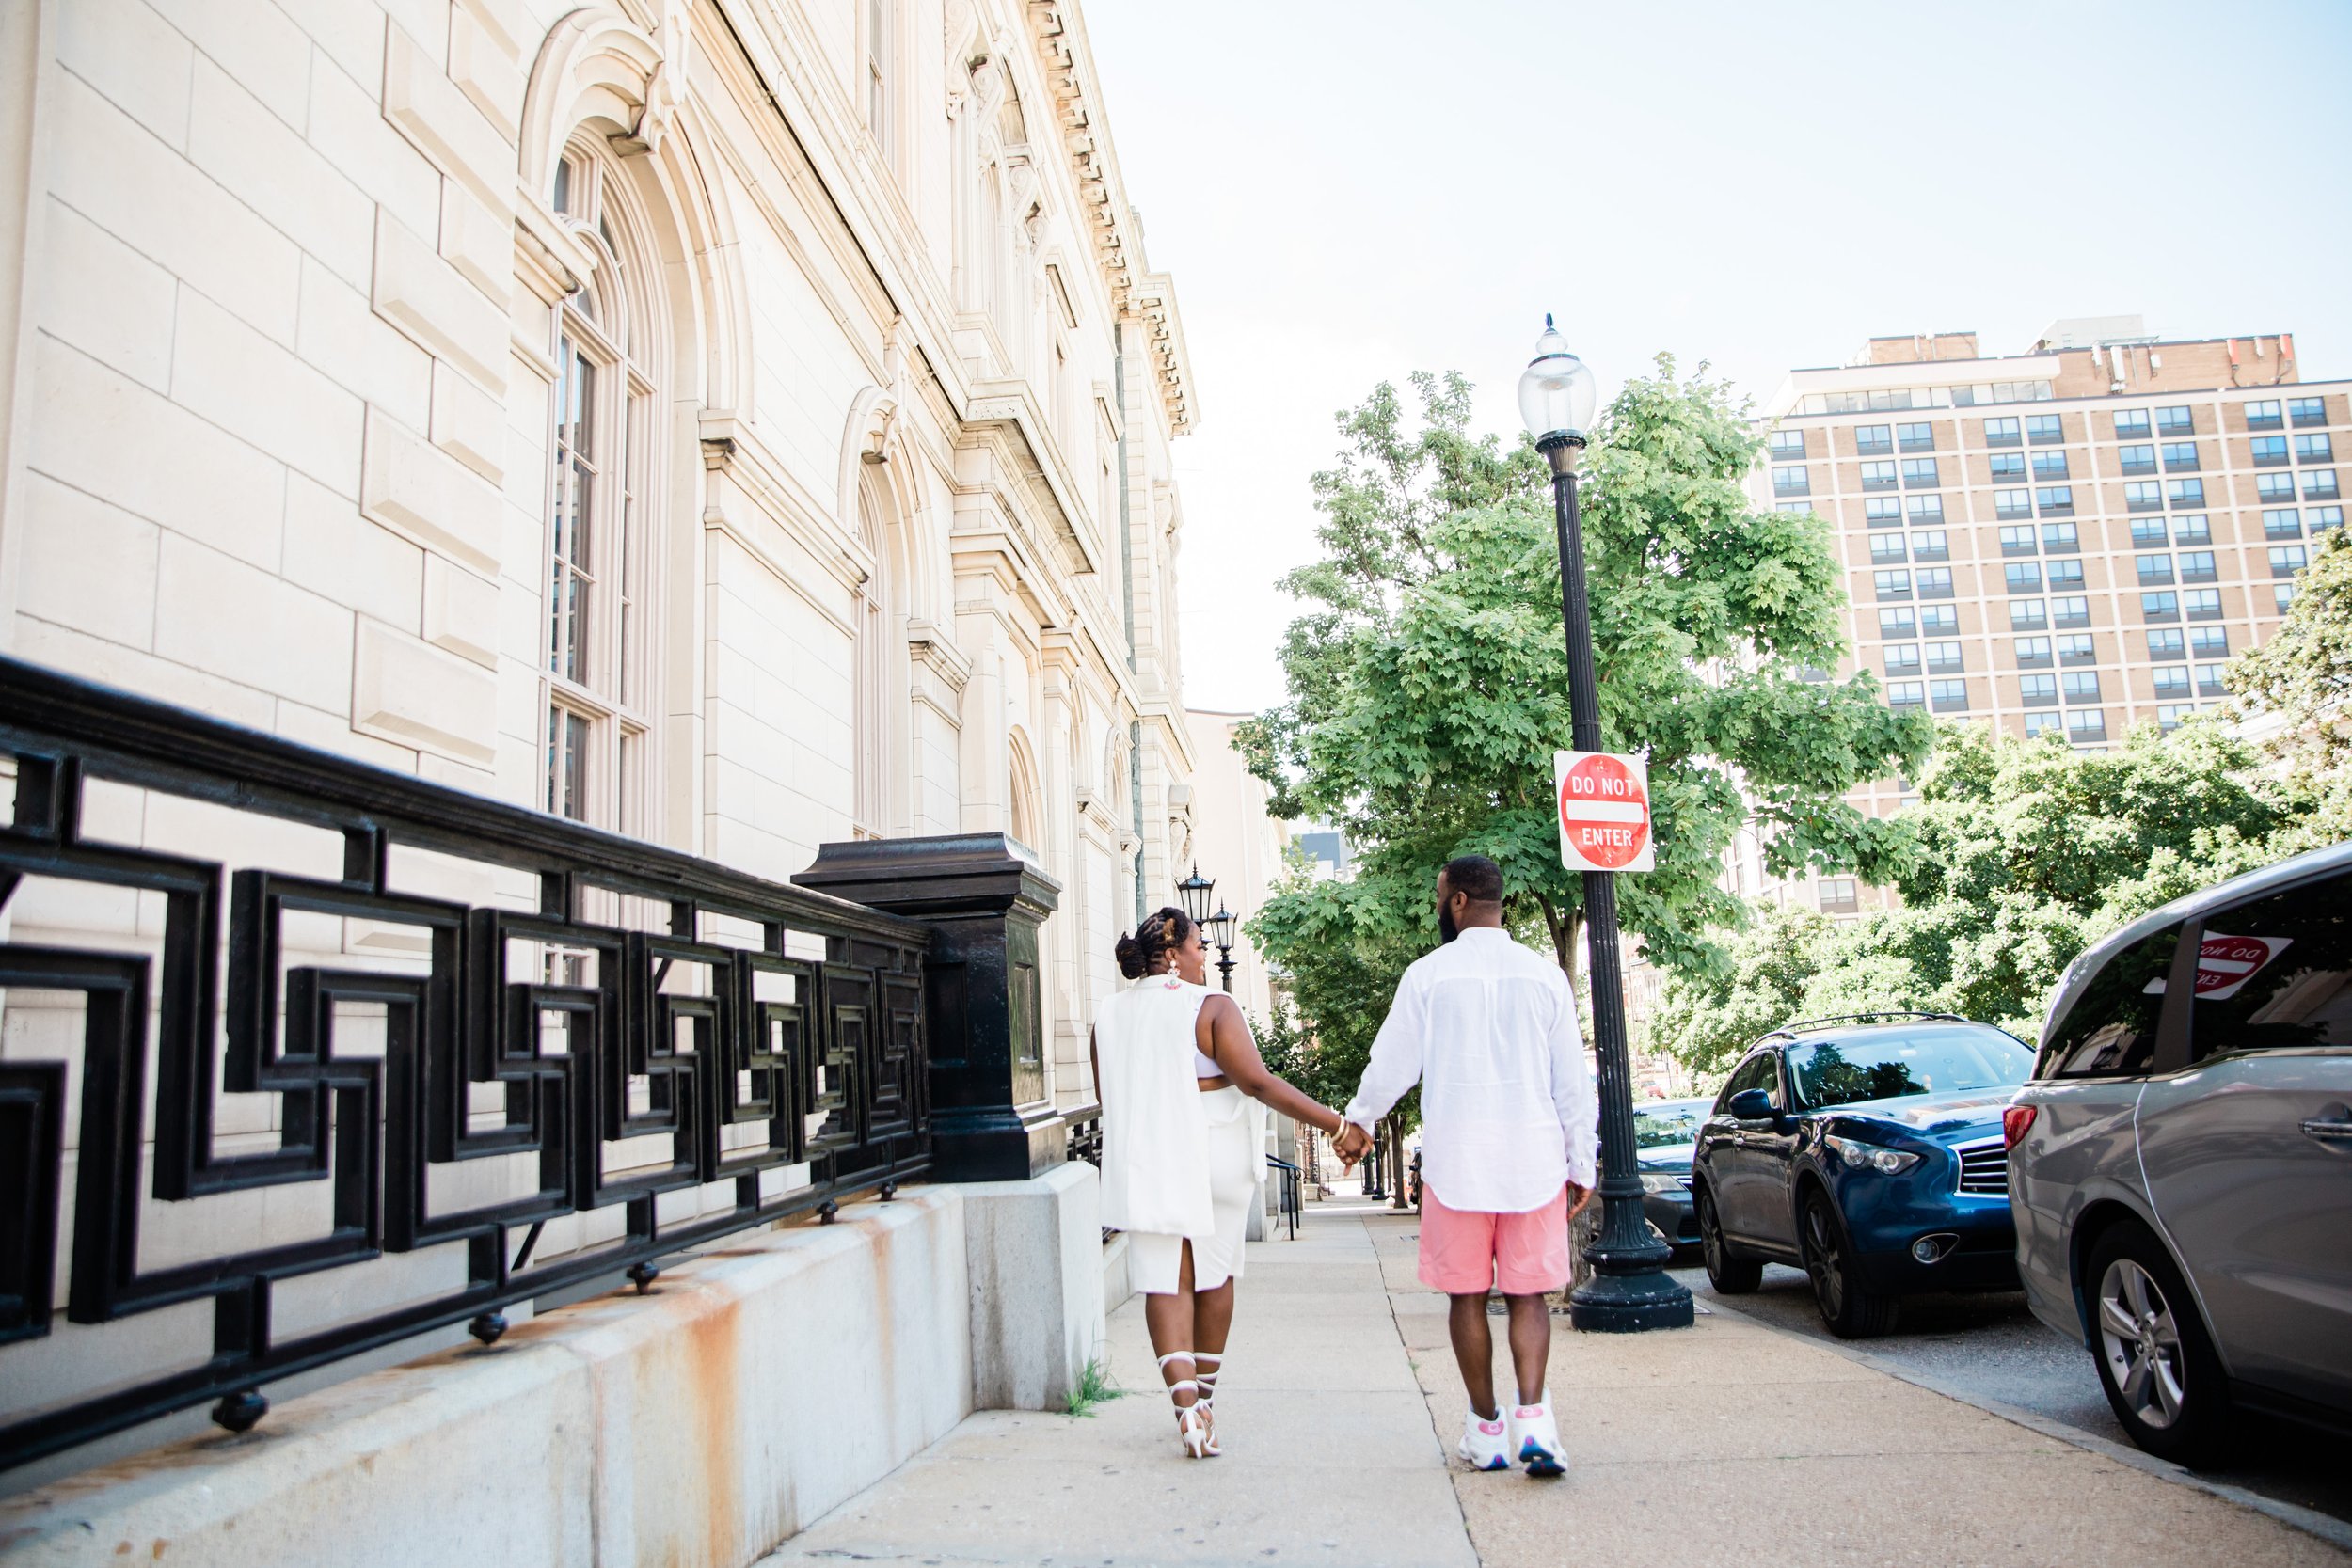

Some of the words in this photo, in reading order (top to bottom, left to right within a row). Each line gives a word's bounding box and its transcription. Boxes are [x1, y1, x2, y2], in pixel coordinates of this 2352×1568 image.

[1572, 776, 1595, 794] DO
[1602, 778, 1633, 796] NOT
[1582, 828, 1633, 846] ENTER
